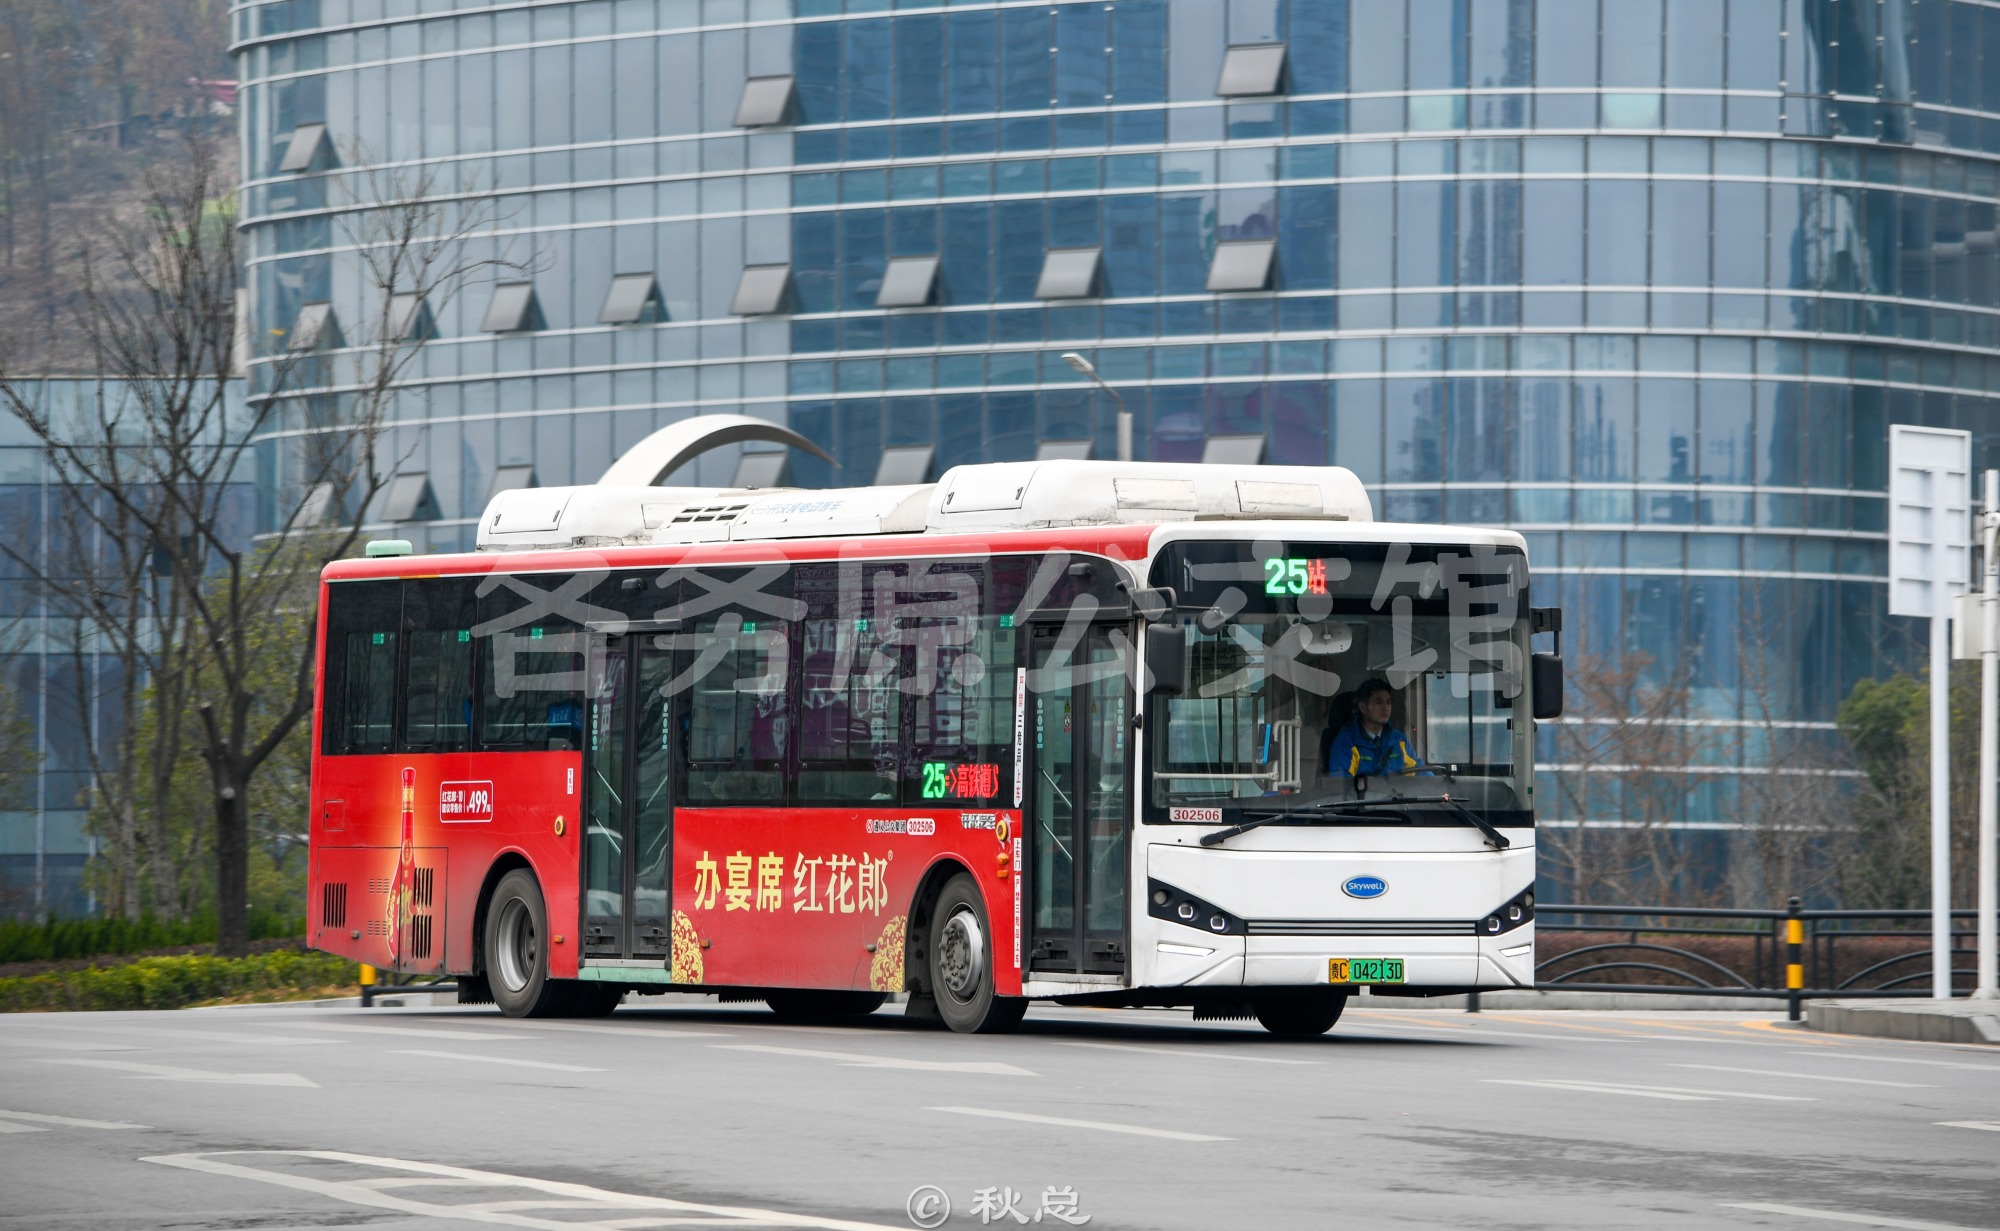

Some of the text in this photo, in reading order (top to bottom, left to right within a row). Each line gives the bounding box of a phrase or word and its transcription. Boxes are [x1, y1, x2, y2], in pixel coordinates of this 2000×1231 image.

[1265, 558, 1308, 594] 25
[923, 763, 945, 798] 25
[908, 820, 935, 833] 302506
[1173, 809, 1220, 821] 302506
[694, 850, 889, 917] 办宴席 红花郎
[1347, 882, 1383, 890] Skywell
